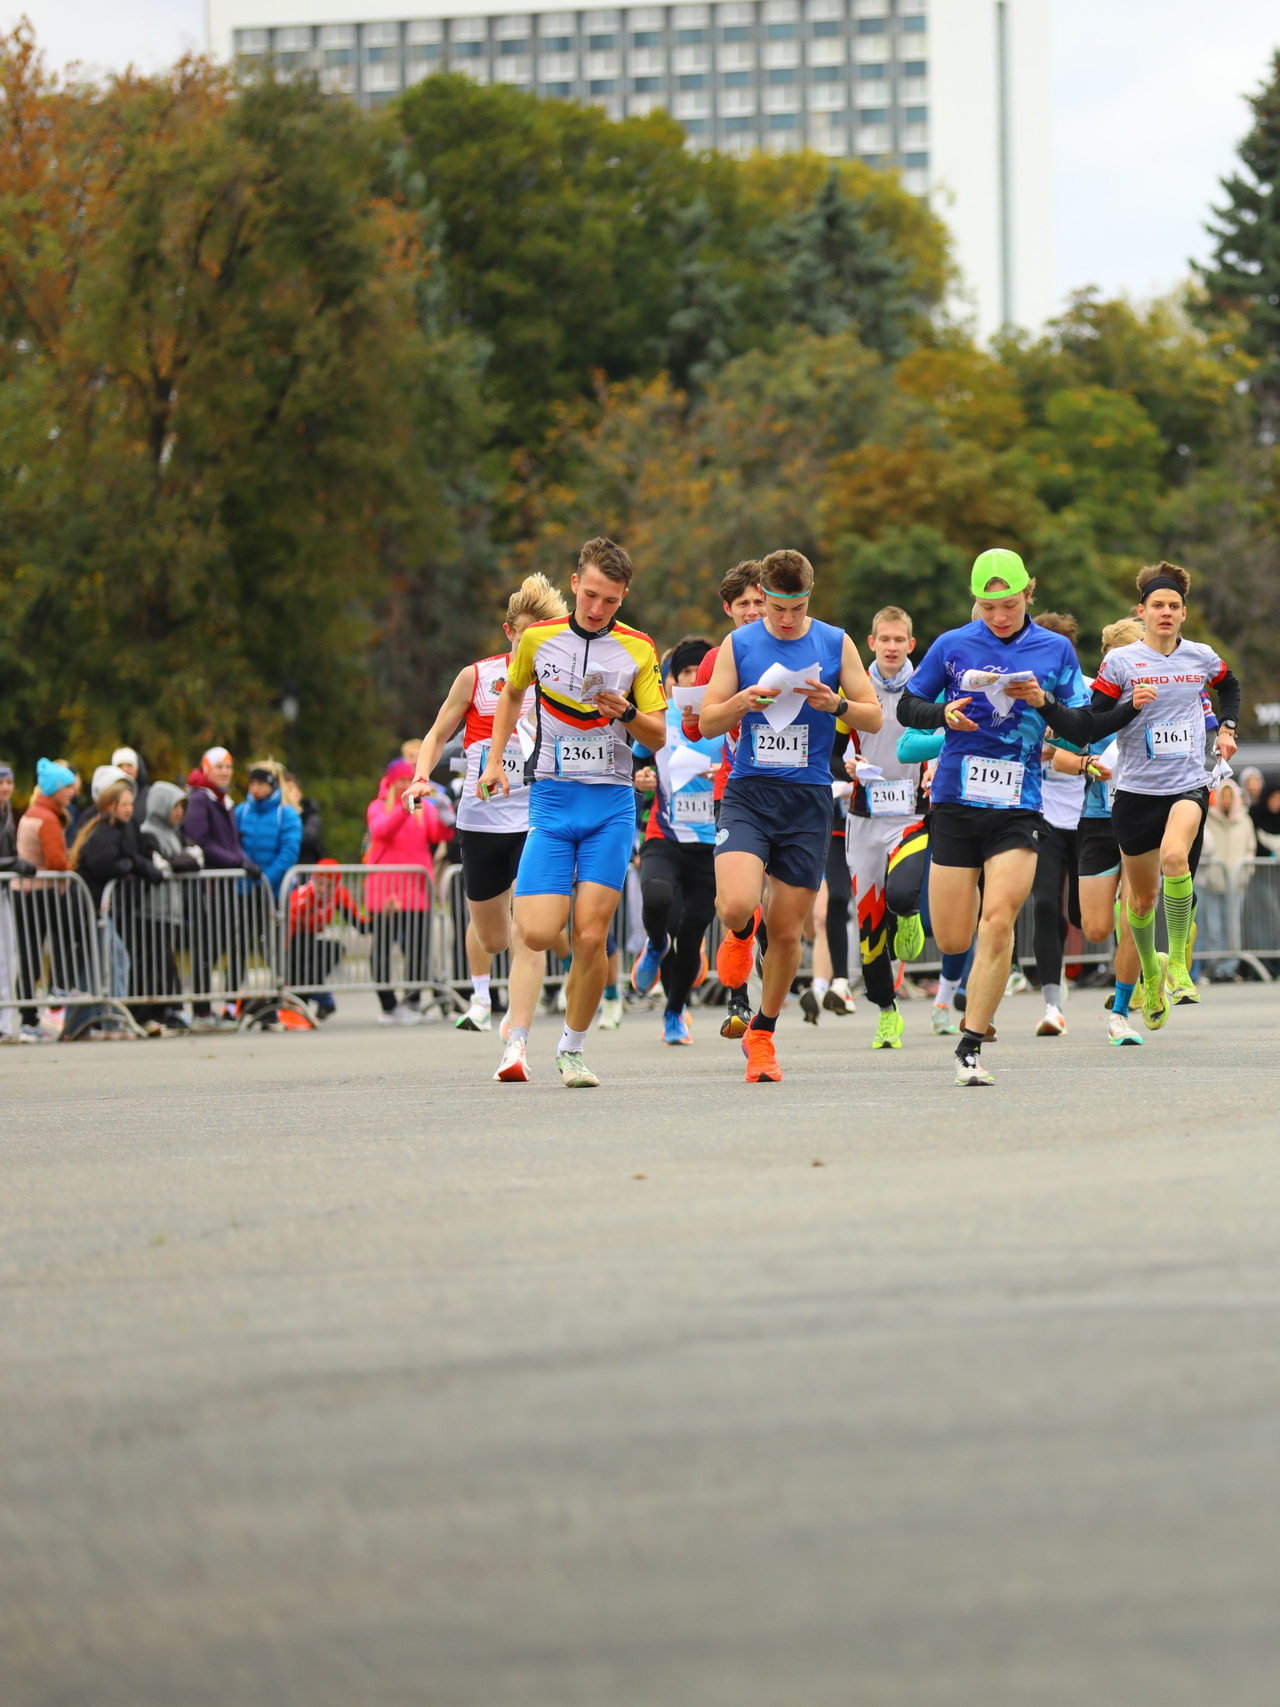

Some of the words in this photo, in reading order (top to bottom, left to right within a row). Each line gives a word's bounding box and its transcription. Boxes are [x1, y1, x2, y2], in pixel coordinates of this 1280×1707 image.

[1173, 675, 1205, 683] WEST
[758, 735, 798, 750] 220.1
[1154, 729, 1187, 744] 216.1
[562, 746, 603, 760] 236.1
[969, 766, 1012, 785] 219.1
[873, 790, 905, 803] 230.1
[677, 801, 706, 811] 231.1
